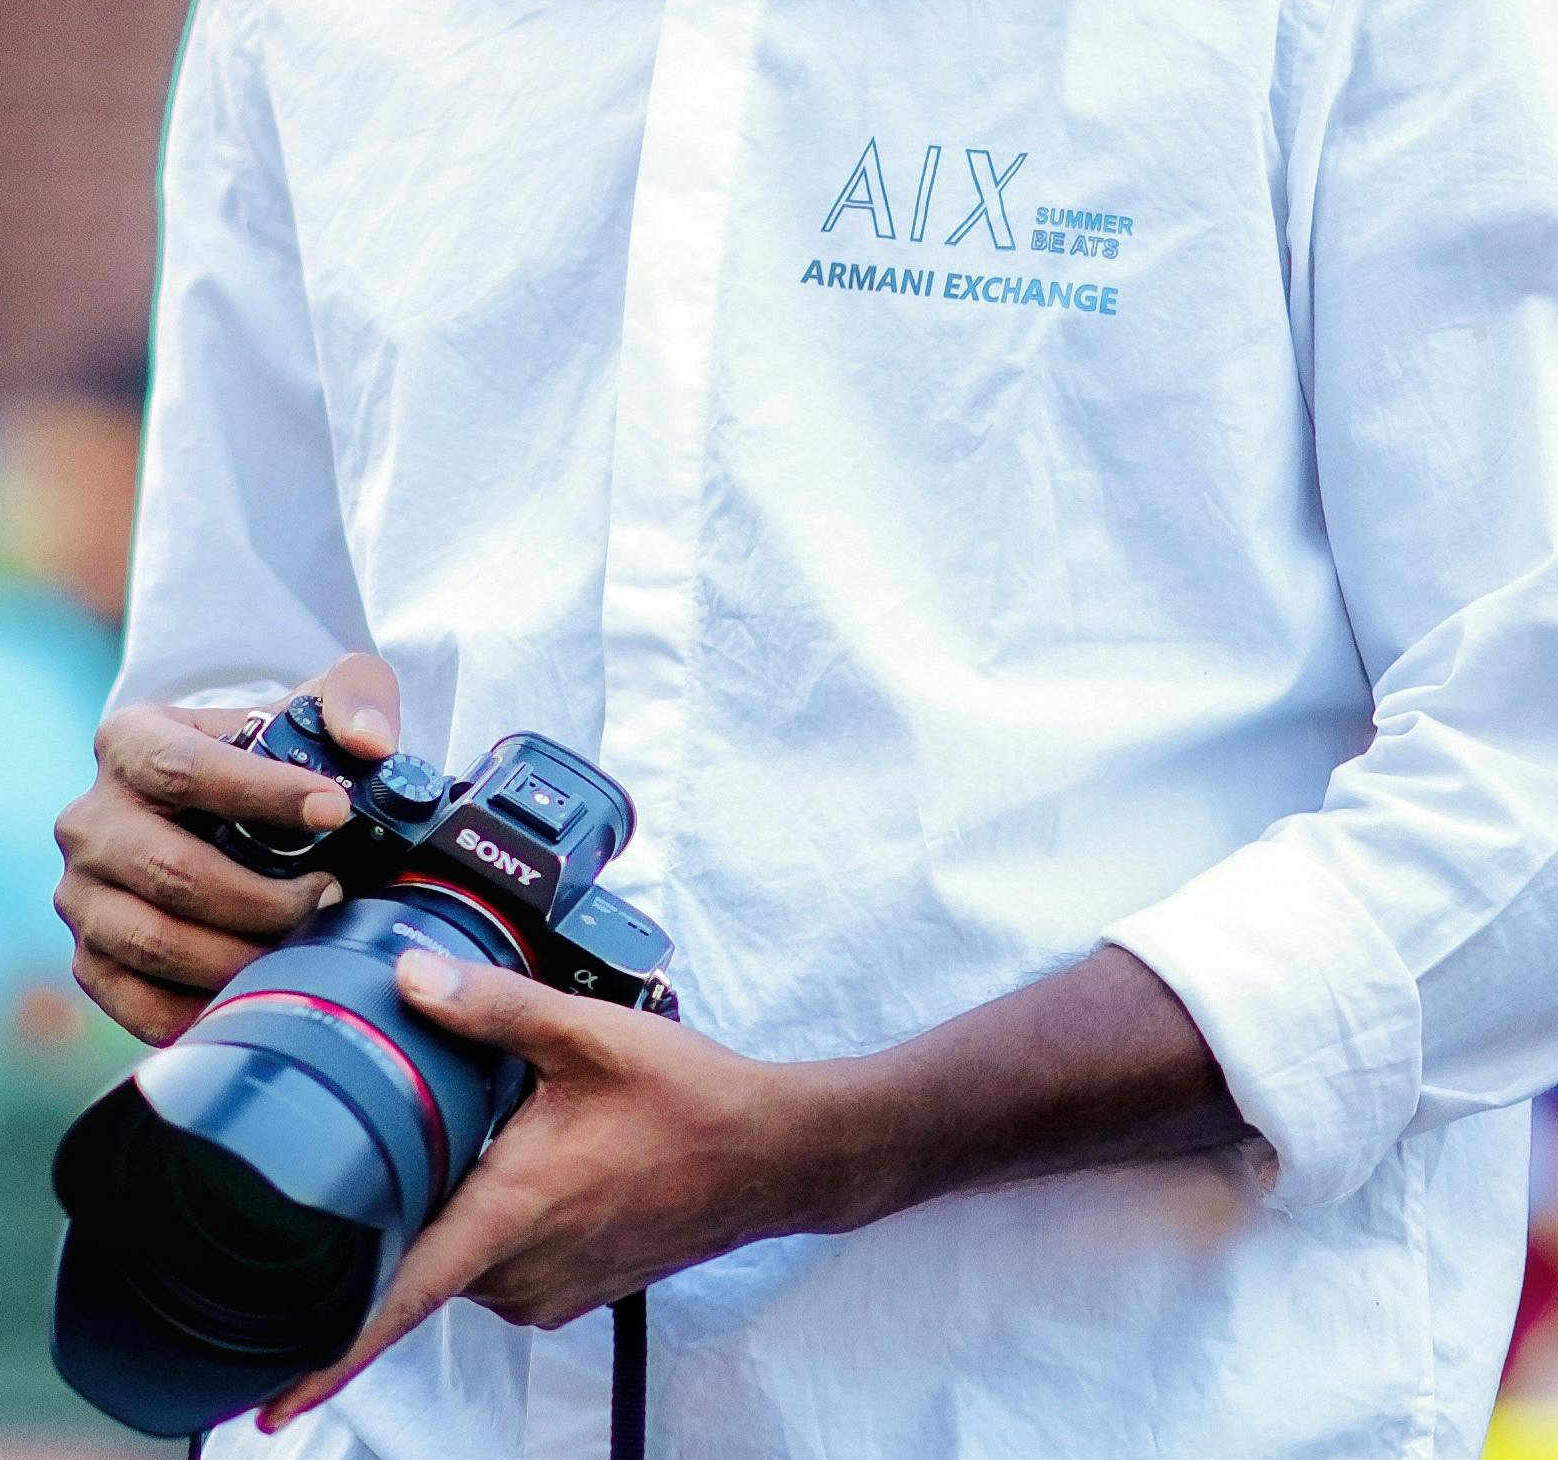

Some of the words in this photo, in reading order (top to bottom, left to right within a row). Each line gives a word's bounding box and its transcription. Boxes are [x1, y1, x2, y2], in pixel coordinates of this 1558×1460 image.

[1035, 206, 1134, 236] SUMMER
[800, 259, 935, 297] ARMANI
[943, 272, 1119, 316] EXCHANGE
[456, 828, 542, 886] SONY
